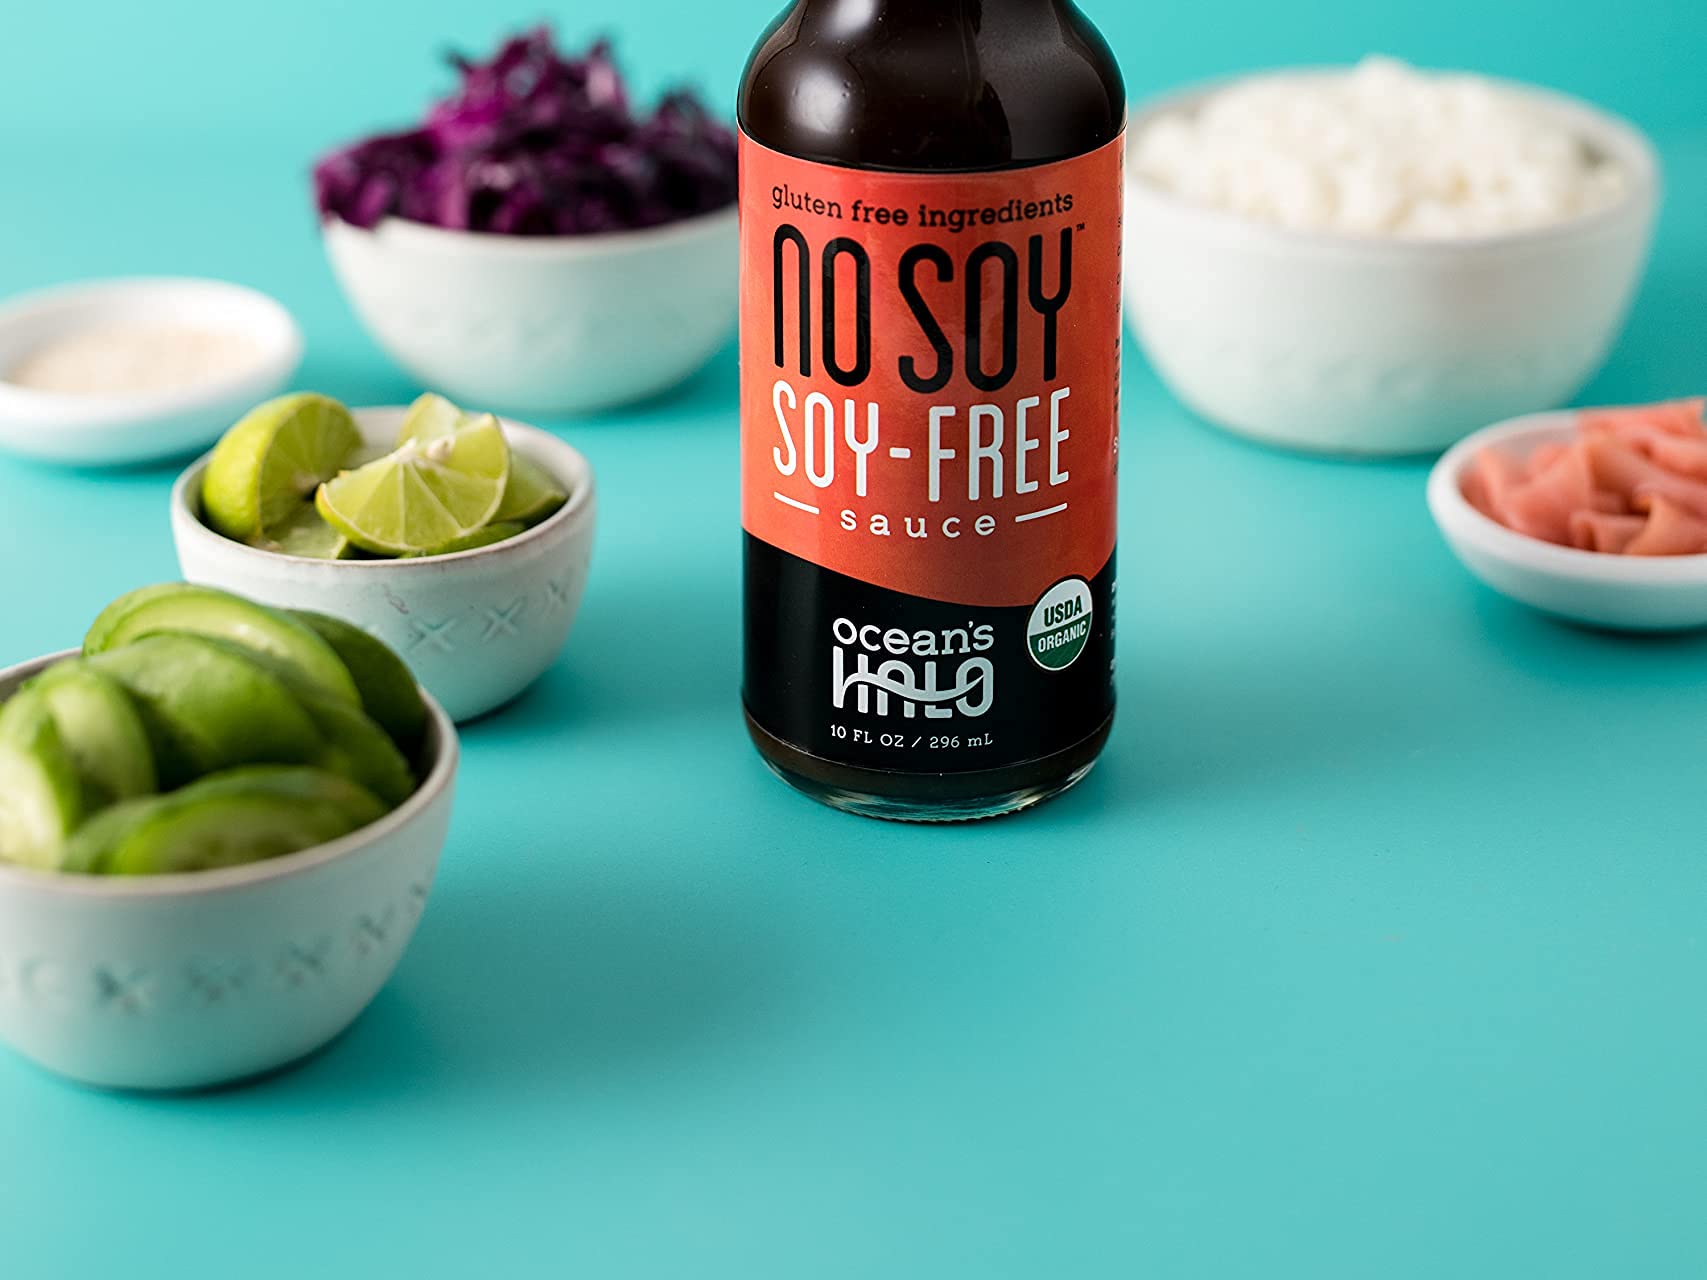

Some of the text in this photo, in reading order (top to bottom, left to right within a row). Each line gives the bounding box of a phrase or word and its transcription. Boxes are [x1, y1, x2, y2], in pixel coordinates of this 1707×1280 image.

[772, 184, 1073, 233] gluten free ingredients
[772, 223, 871, 387] NO
[897, 226, 1073, 394] SOY
[840, 508, 996, 539] sauce
[1043, 595, 1083, 627] USDA
[1037, 624, 1087, 653] ORGANIC
[832, 646, 994, 719] HALO
[830, 724, 847, 740] 10
[853, 729, 873, 745] FL
[880, 733, 904, 748] OZ
[929, 736, 960, 749] 296
[967, 733, 993, 747] mL
